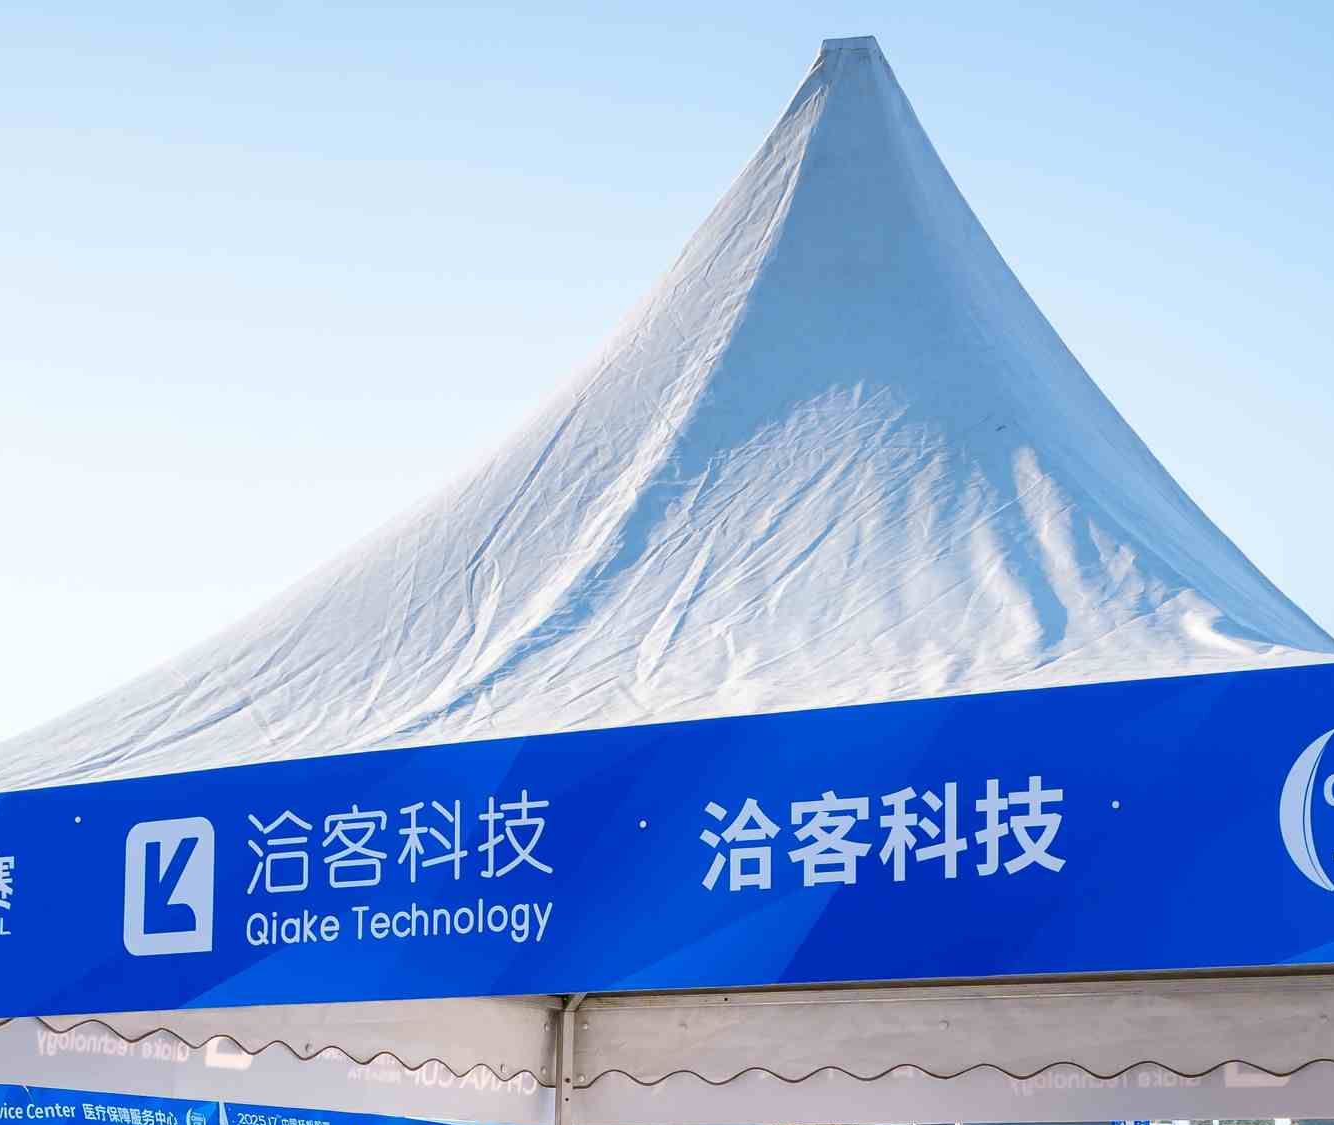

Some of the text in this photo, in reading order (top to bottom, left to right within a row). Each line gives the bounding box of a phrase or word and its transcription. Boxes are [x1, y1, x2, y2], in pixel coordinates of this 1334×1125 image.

[246, 789, 553, 895] 洽客科技
[699, 775, 1067, 891] 洽客科技
[246, 898, 554, 947] Qiake Technology
[26, 1103, 76, 1120] Center
